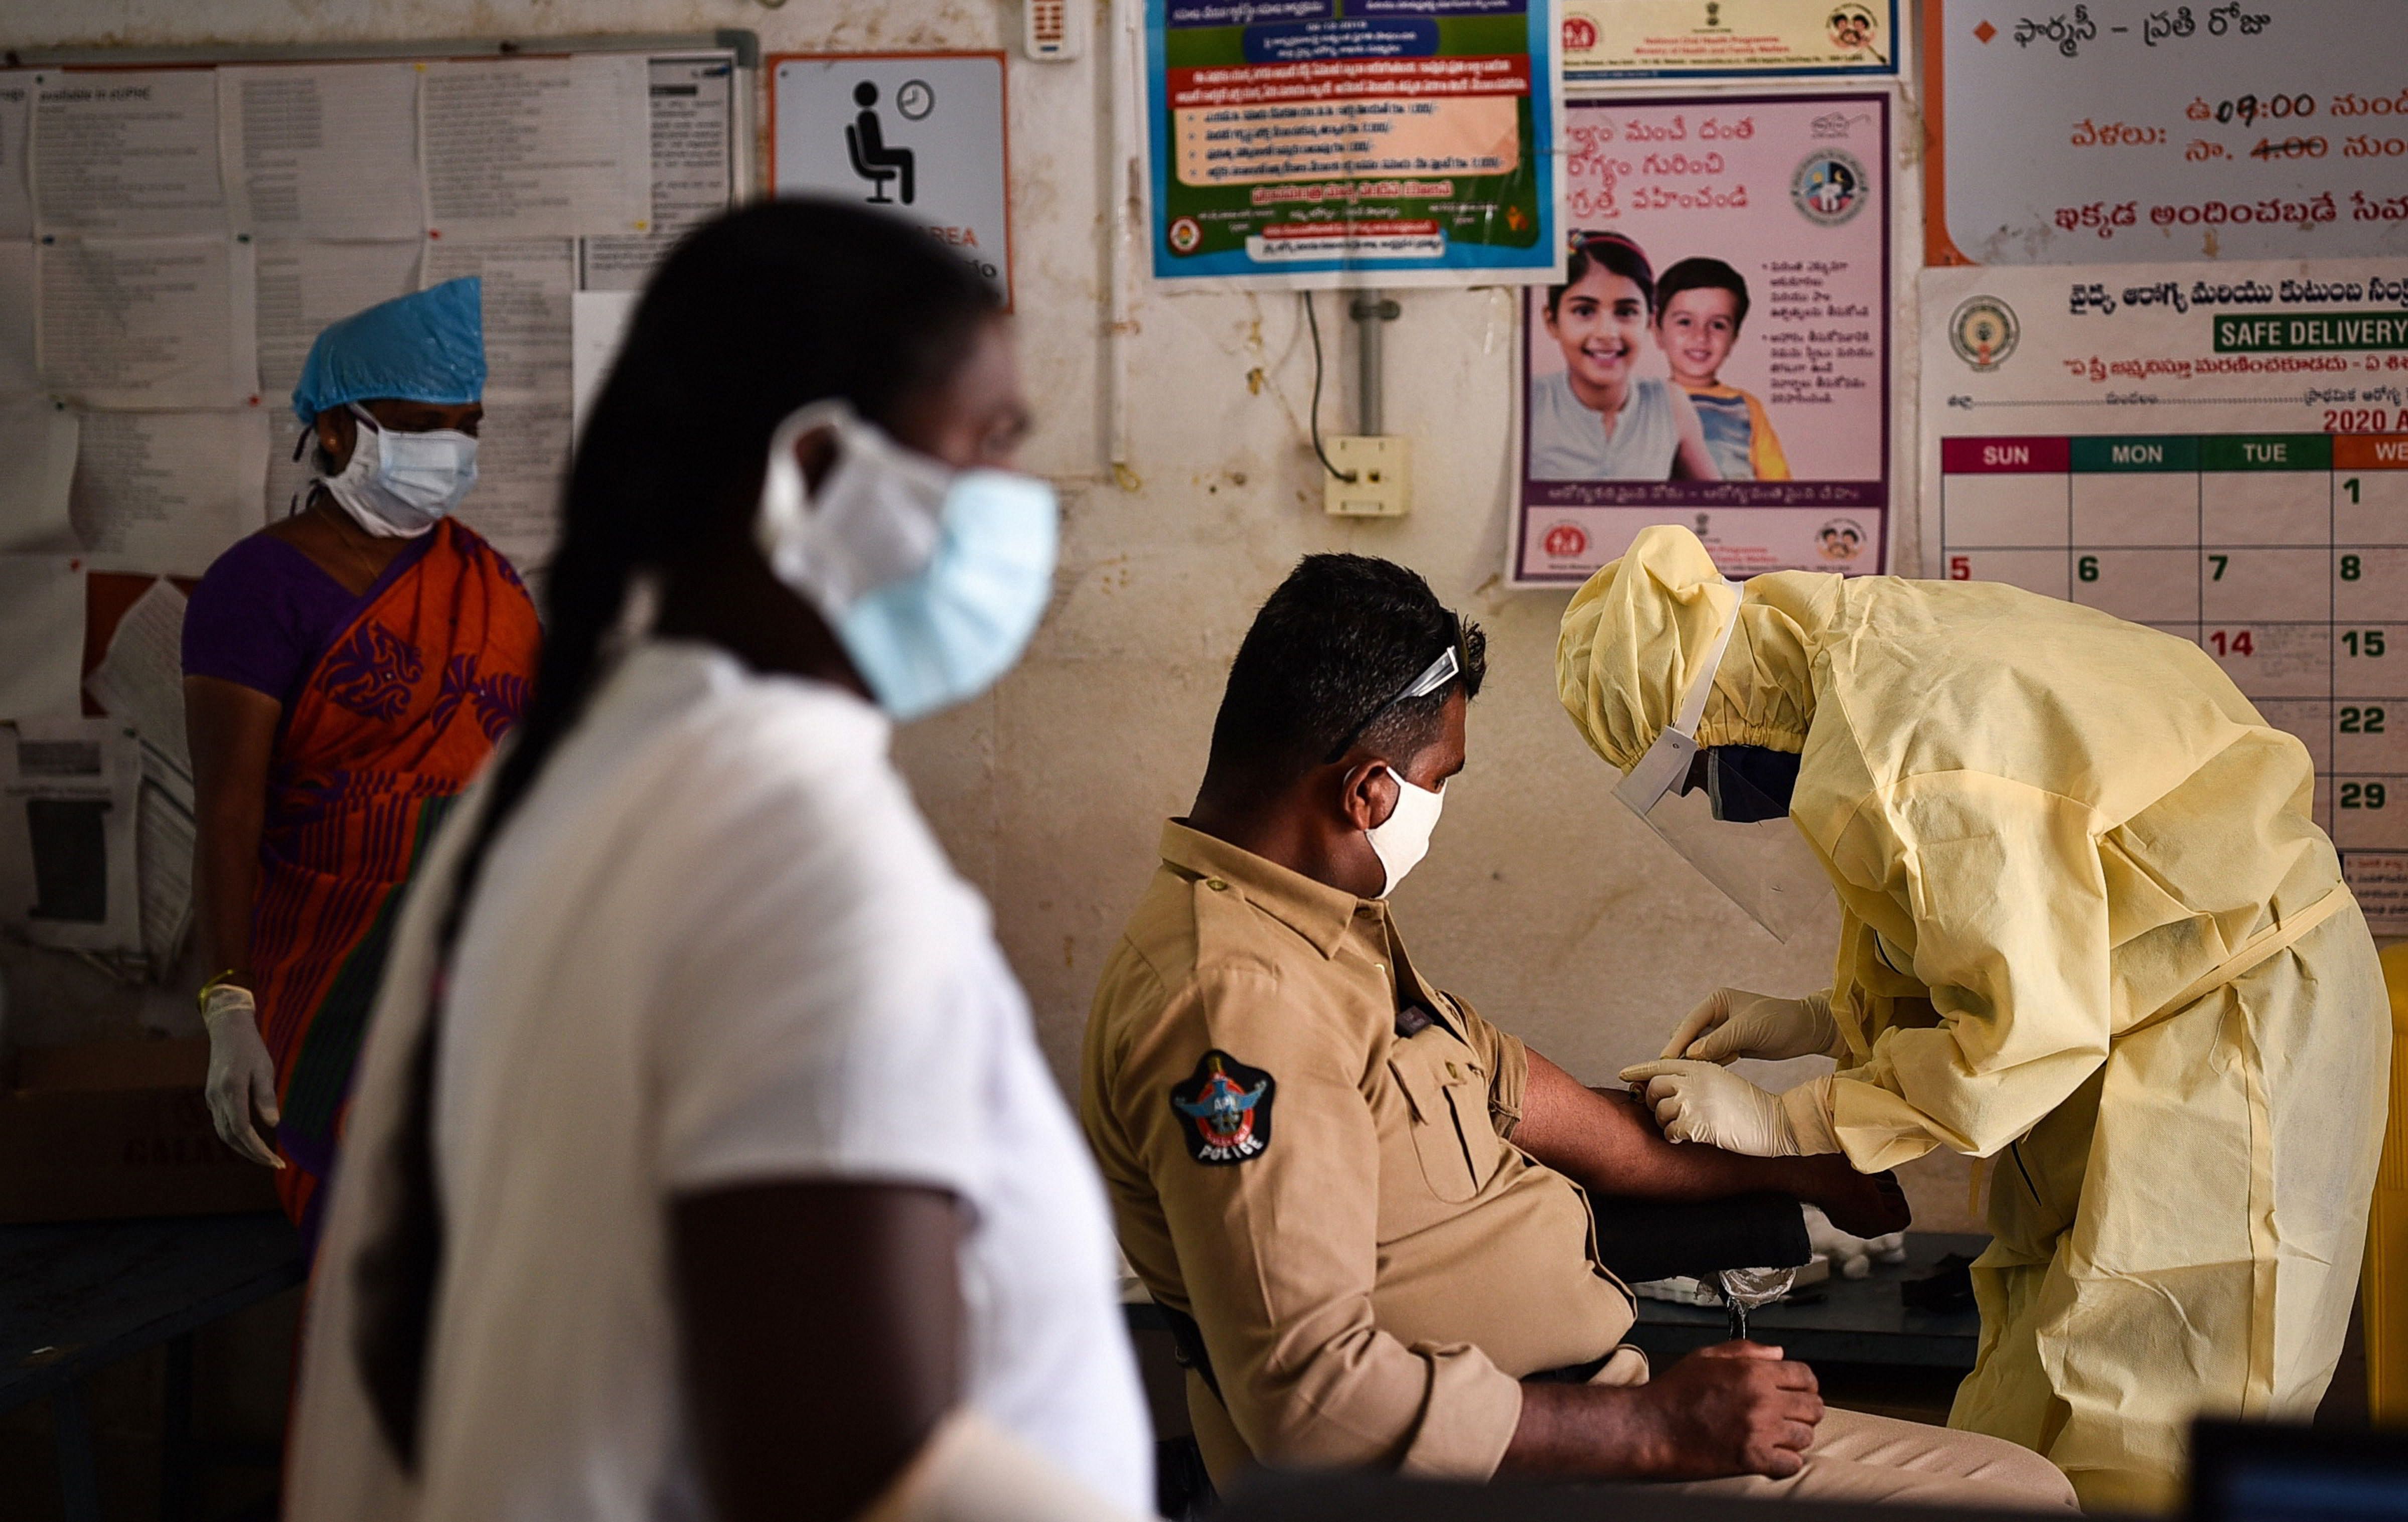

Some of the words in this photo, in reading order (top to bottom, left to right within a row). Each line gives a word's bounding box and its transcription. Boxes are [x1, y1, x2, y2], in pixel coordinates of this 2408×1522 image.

[2014, 4, 2097, 56] ఫార్మసీ
[2144, 8, 2196, 46] ప్రతి
[2208, 2, 2272, 37] రోజు
[1566, 125, 1614, 154] ల్యం
[2070, 117, 2167, 147] వేళలు:
[2343, 133, 2408, 158] నుం
[1567, 153, 1632, 188] రోగ్యం
[1566, 188, 1621, 219] గ్రత్త
[2055, 201, 2137, 239] ఇక్కడ
[2150, 191, 2338, 227] అందించబడే
[2191, 279, 2273, 305] మరియు
[2221, 320, 2282, 347] SAFE
[2290, 317, 2408, 346] DELIVERY
[2323, 409, 2386, 432] 2020
[1982, 445, 2030, 465] SUN
[2112, 444, 2163, 463] MON
[2243, 443, 2287, 462] TUE
[2343, 478, 2360, 505] 1
[1950, 556, 1971, 581] 5
[2078, 555, 2099, 582] 6
[2208, 555, 2228, 581] 7
[2340, 554, 2361, 581] 8
[2210, 631, 2253, 657] 14
[2342, 631, 2385, 658] 15
[2339, 707, 2384, 734] 22
[2340, 782, 2385, 809] 29
[1198, 1134, 1264, 1161] POLICE
